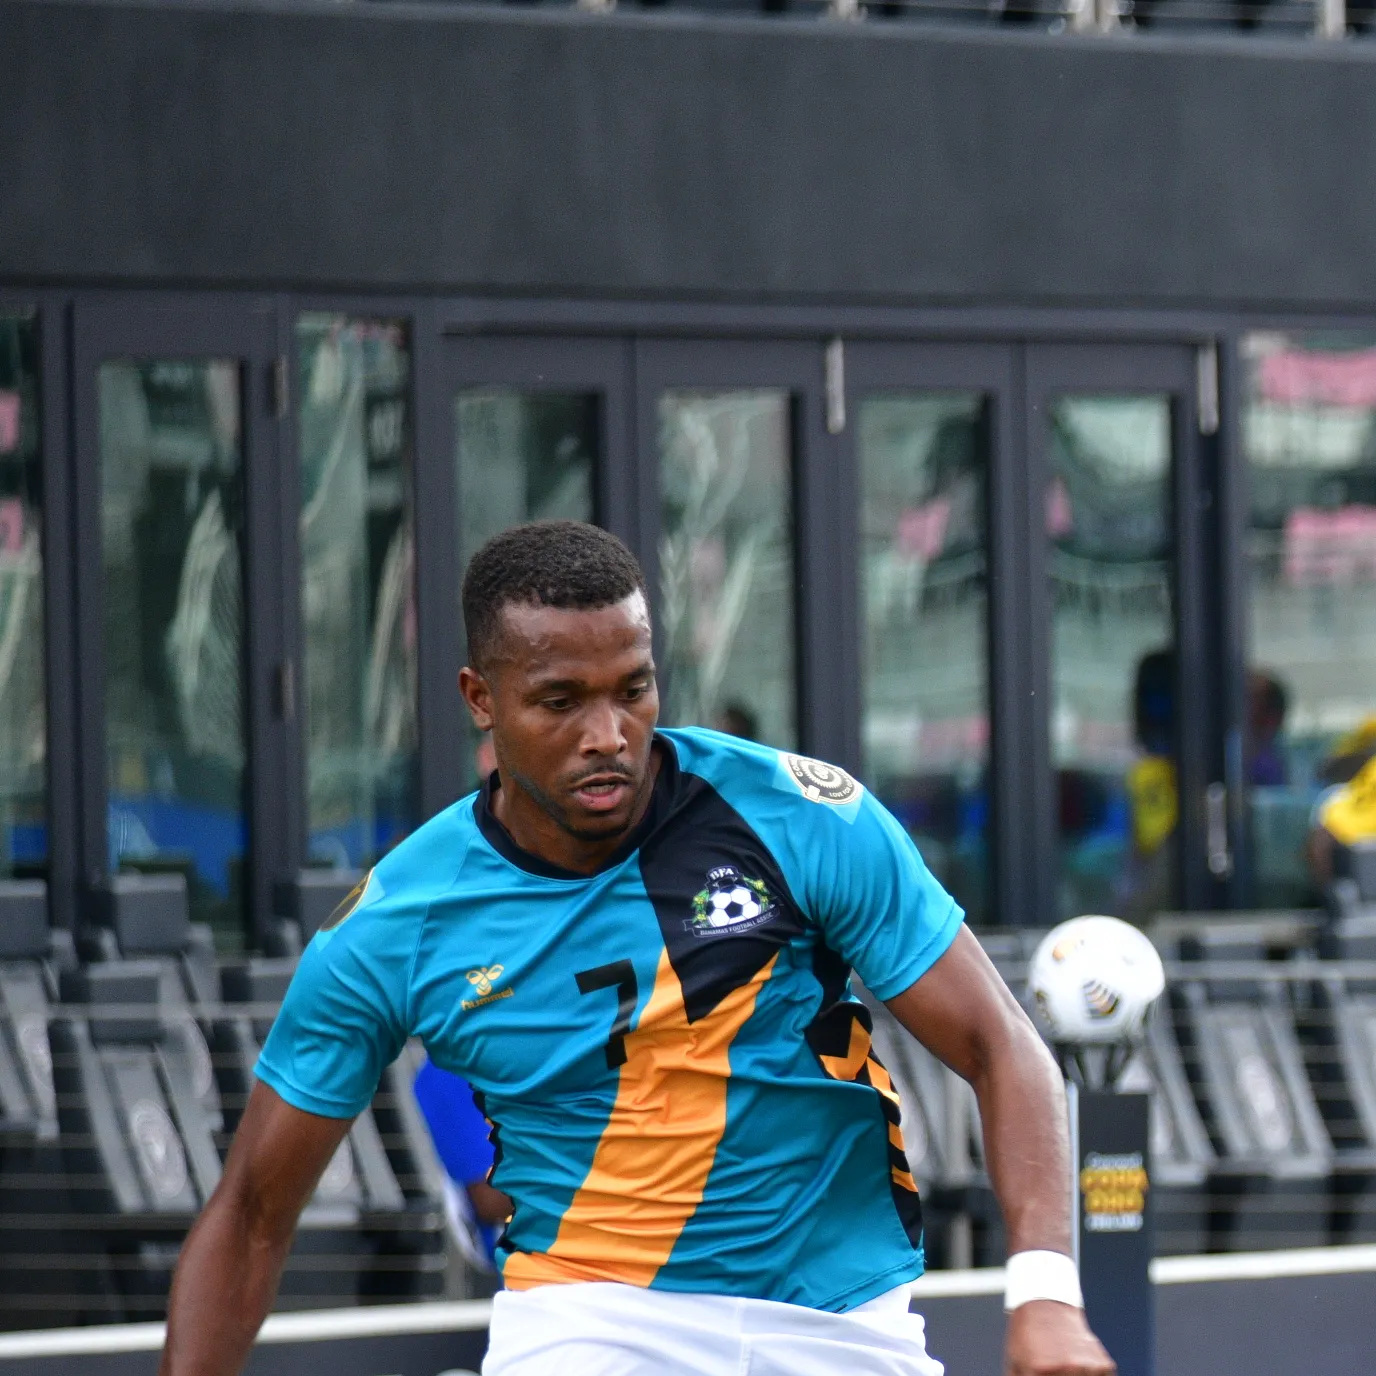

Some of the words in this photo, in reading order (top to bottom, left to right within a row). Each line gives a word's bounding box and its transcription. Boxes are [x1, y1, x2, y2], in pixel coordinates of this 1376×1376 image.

[709, 867, 735, 880] BFA
[461, 987, 514, 1011] hummel
[574, 958, 638, 1071] 7
